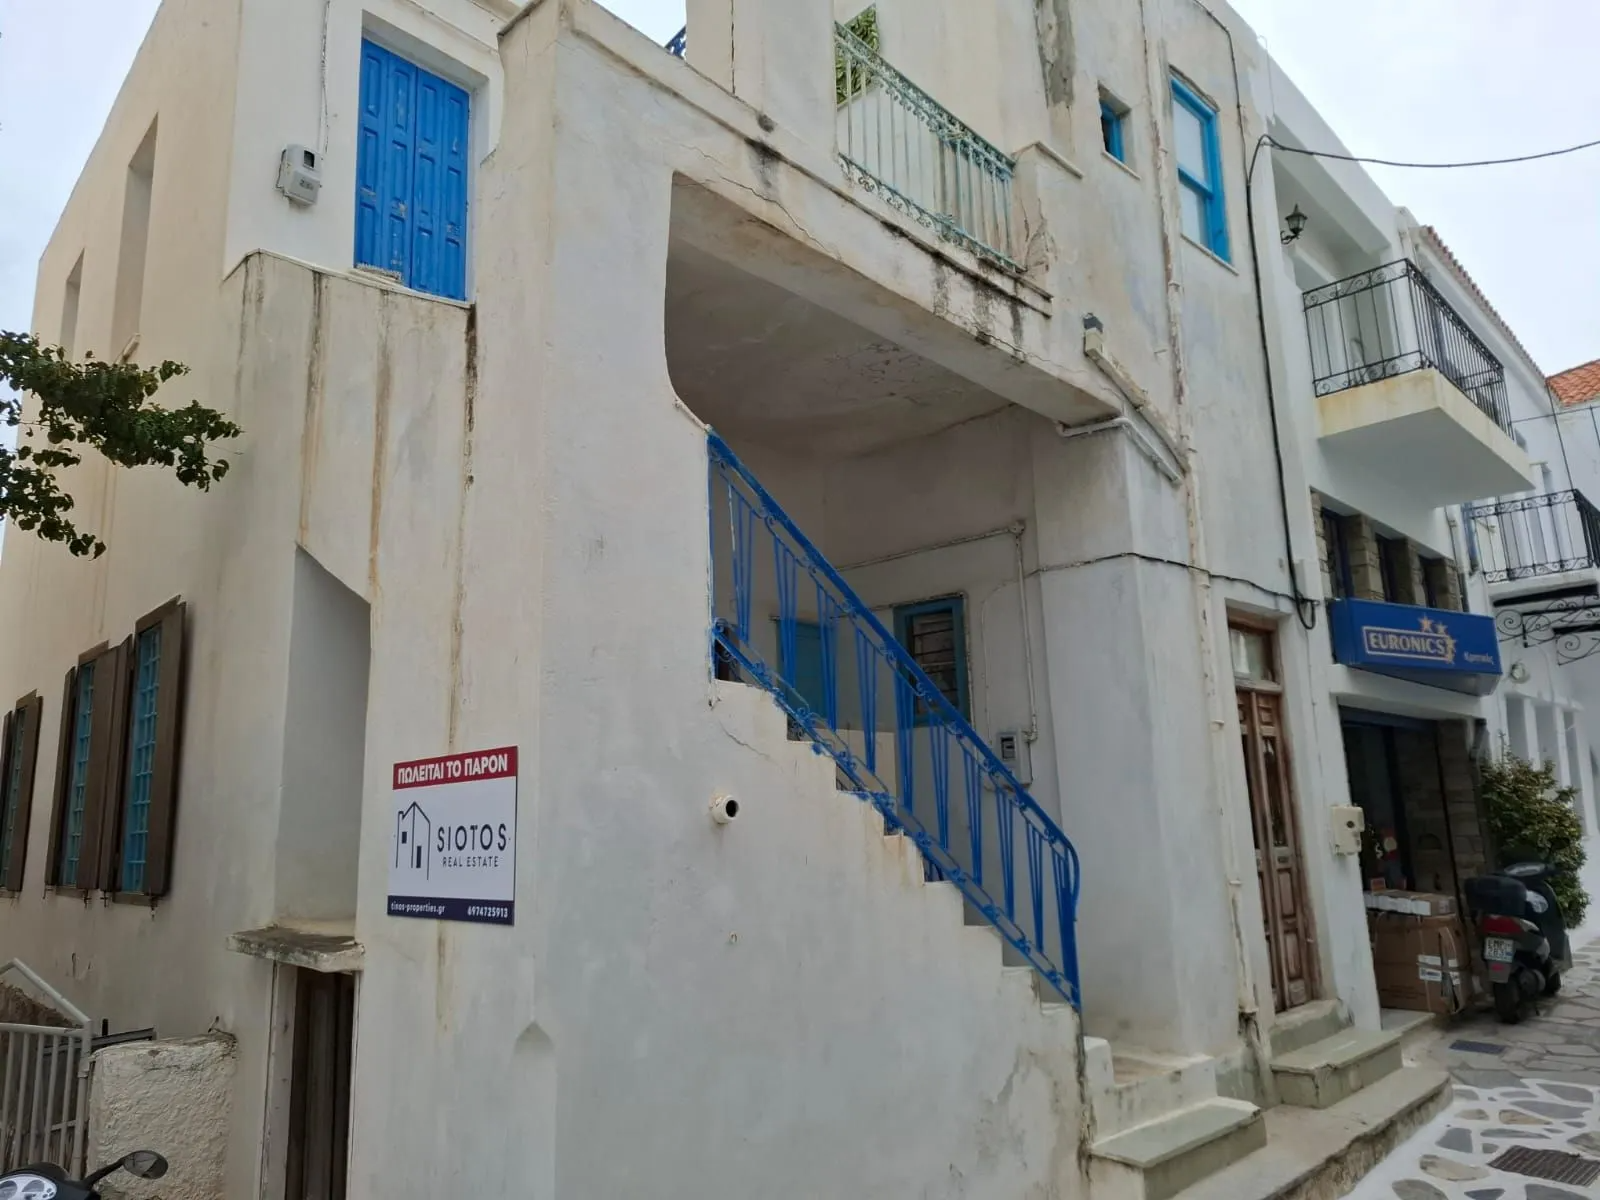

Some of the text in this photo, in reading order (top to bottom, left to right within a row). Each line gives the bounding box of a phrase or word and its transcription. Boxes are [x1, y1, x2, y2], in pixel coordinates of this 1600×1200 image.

[1369, 632, 1446, 655] EURONICS
[398, 753, 508, 785] ΠΩΛΕΙΤΑΙ ΤΟ ΠΑΡΟΝ
[437, 823, 507, 852] SIOTOS
[443, 855, 500, 868] REAL ESTATE
[467, 906, 509, 918] 6974725913
